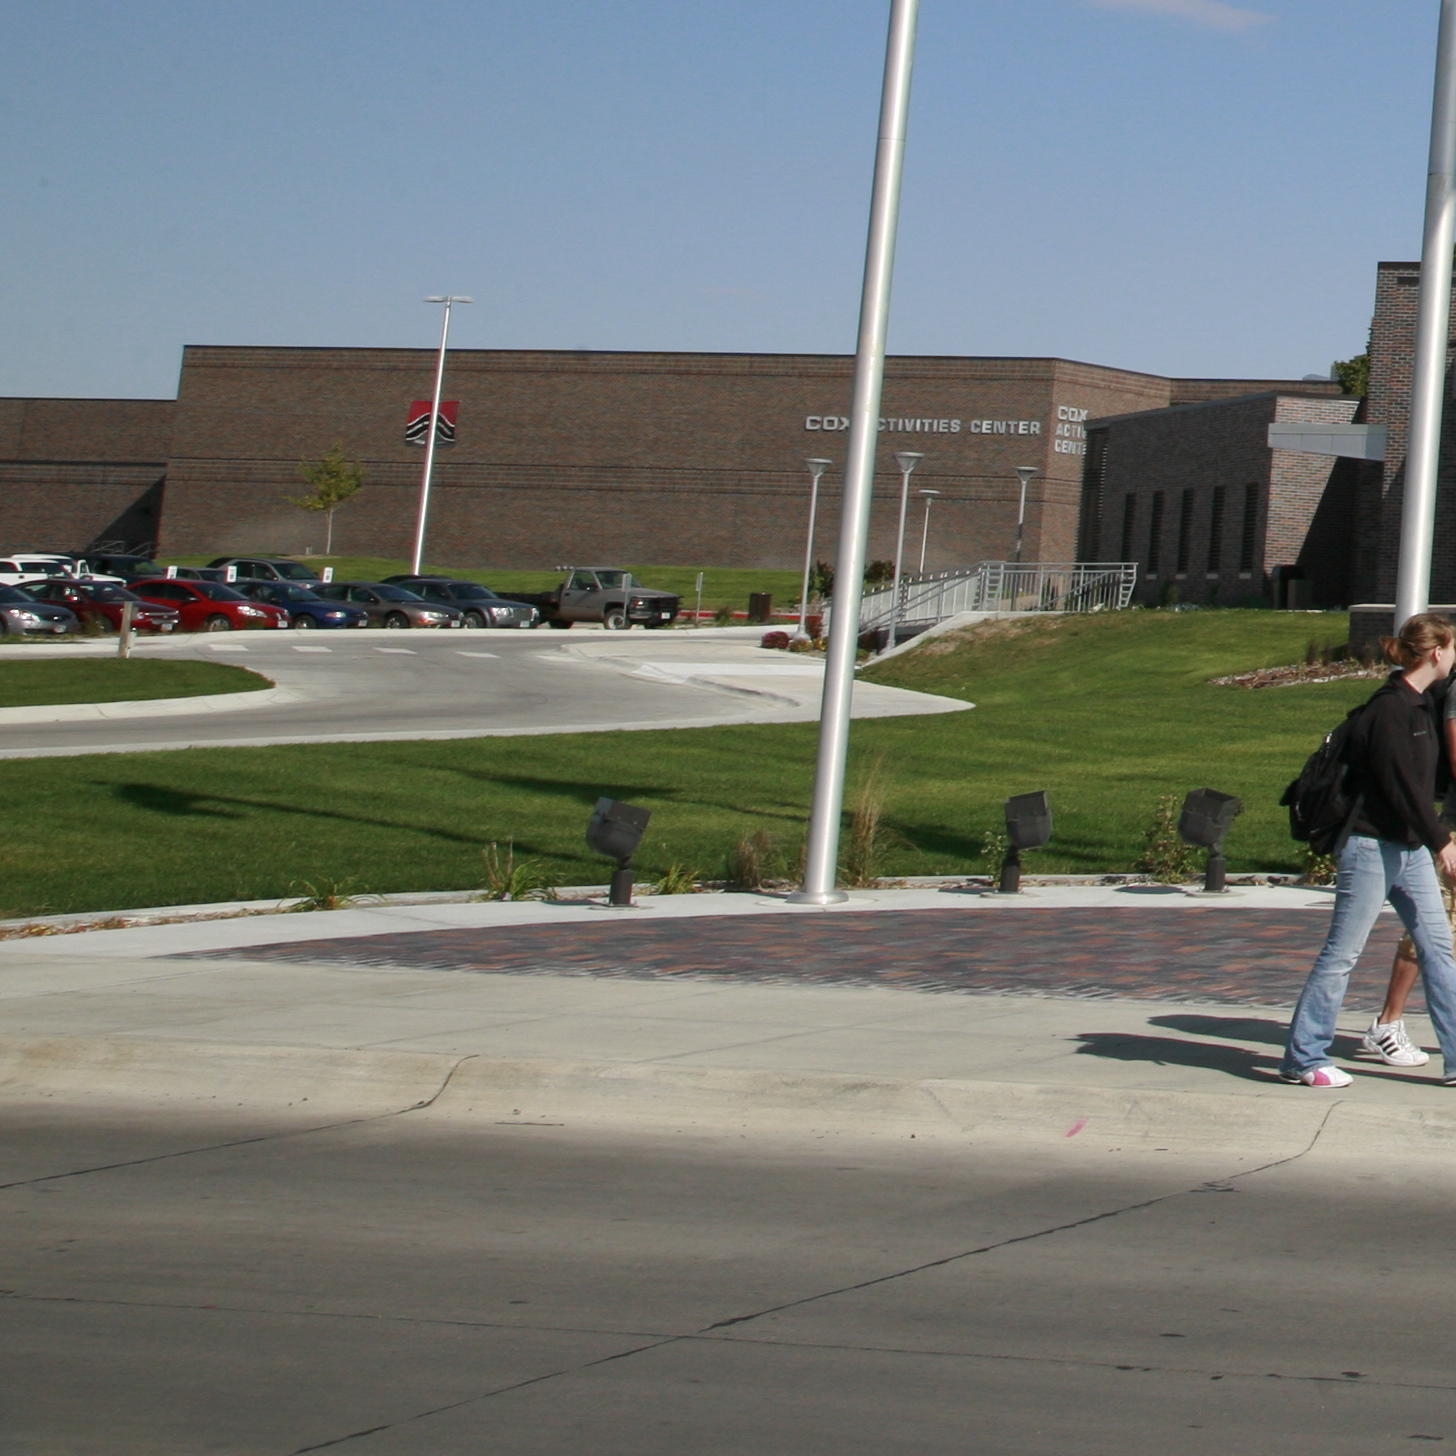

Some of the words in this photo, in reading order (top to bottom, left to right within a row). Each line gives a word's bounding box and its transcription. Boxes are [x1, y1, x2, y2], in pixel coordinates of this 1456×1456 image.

[1058, 406, 1089, 422] COX
[877, 417, 961, 433] CTIVITIES
[970, 420, 1041, 434] CENTER
[1055, 440, 1087, 454] CENT
